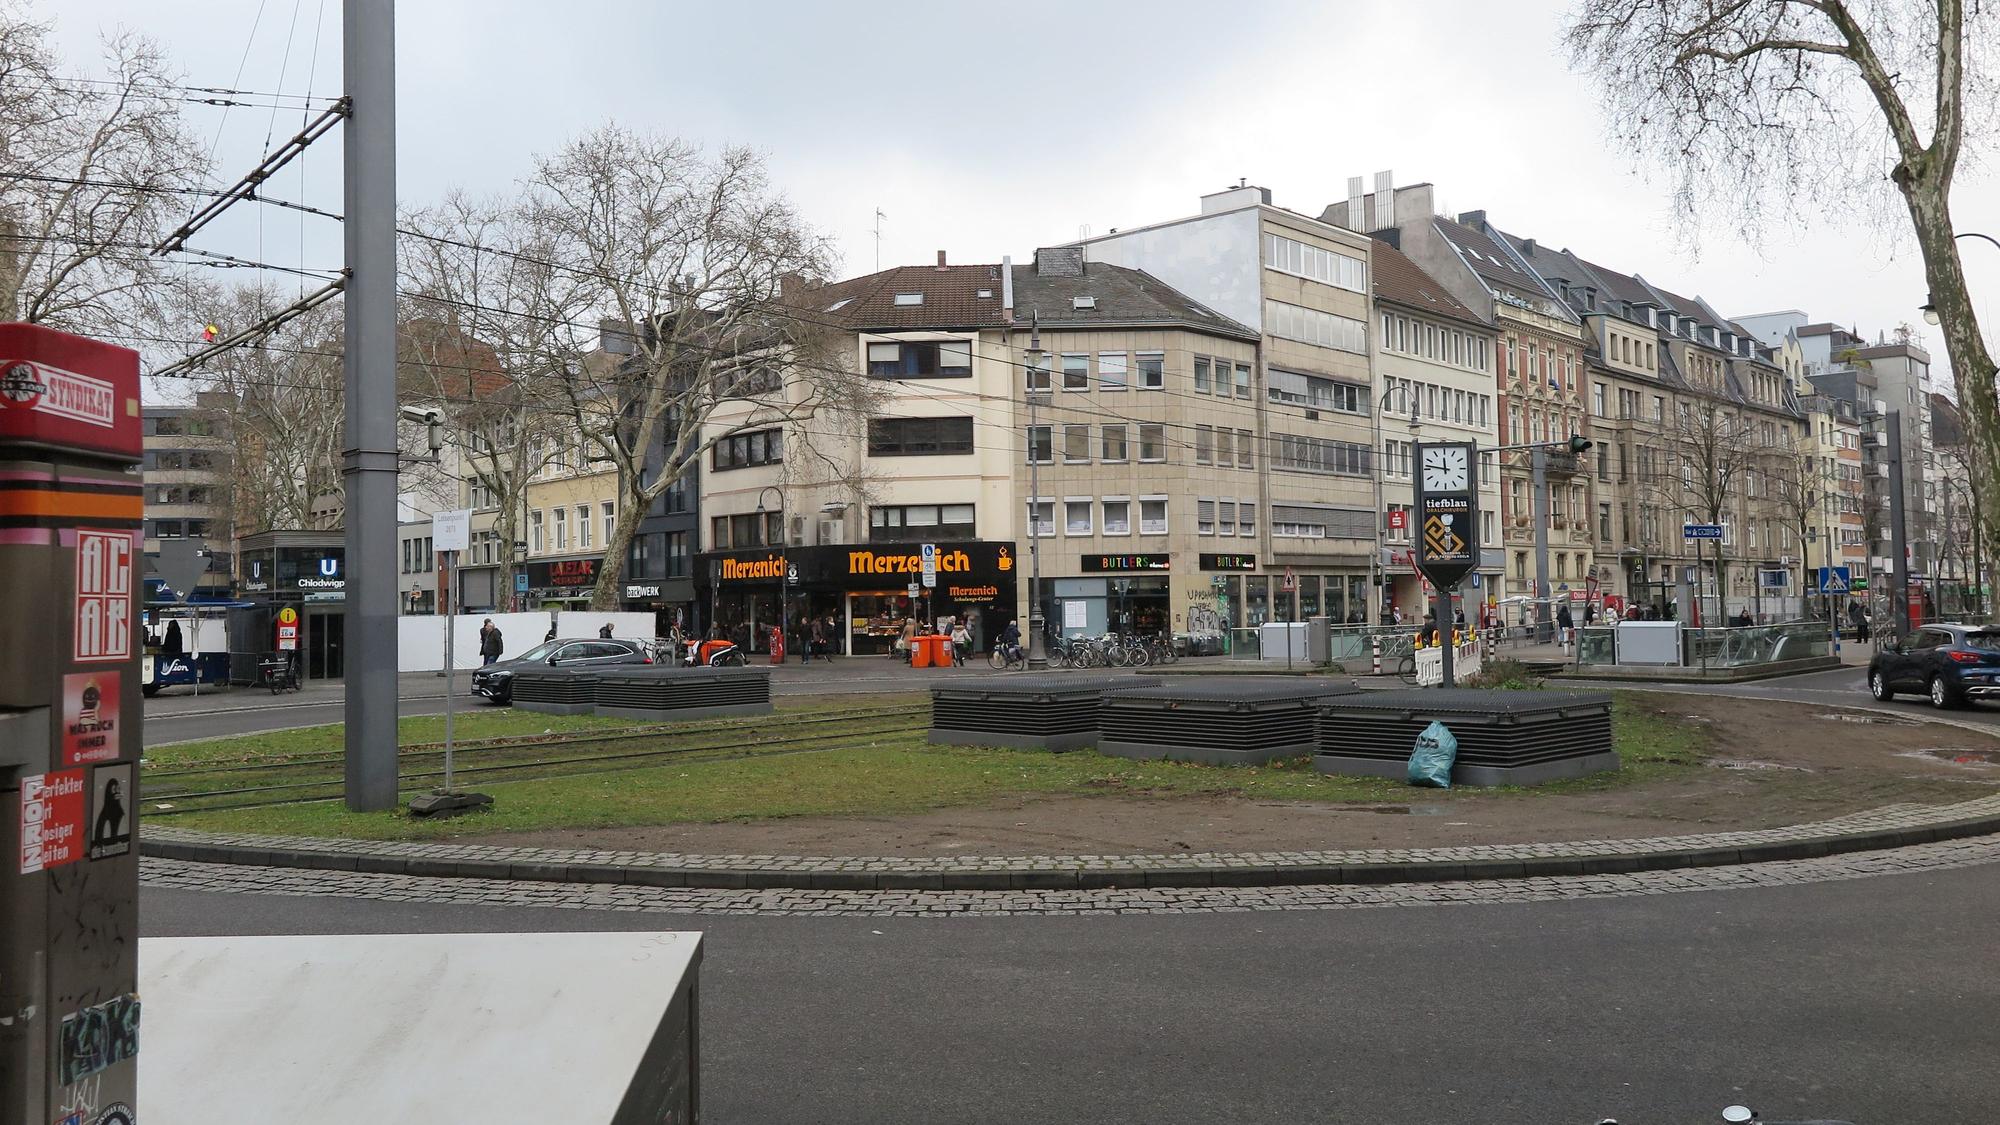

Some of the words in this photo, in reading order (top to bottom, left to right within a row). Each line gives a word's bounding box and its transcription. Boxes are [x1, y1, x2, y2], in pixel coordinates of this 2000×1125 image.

[48, 376, 113, 419] SYNDIKAT
[1426, 499, 1468, 508] tiefblau
[848, 548, 970, 574] Merzeich
[1102, 557, 1149, 568] BUTLERS
[1217, 556, 1244, 568] BUTLERS
[321, 559, 336, 576] U
[298, 578, 345, 589] Chlodwigp
[949, 586, 998, 596] Merzenich
[160, 658, 189, 676] Sion
